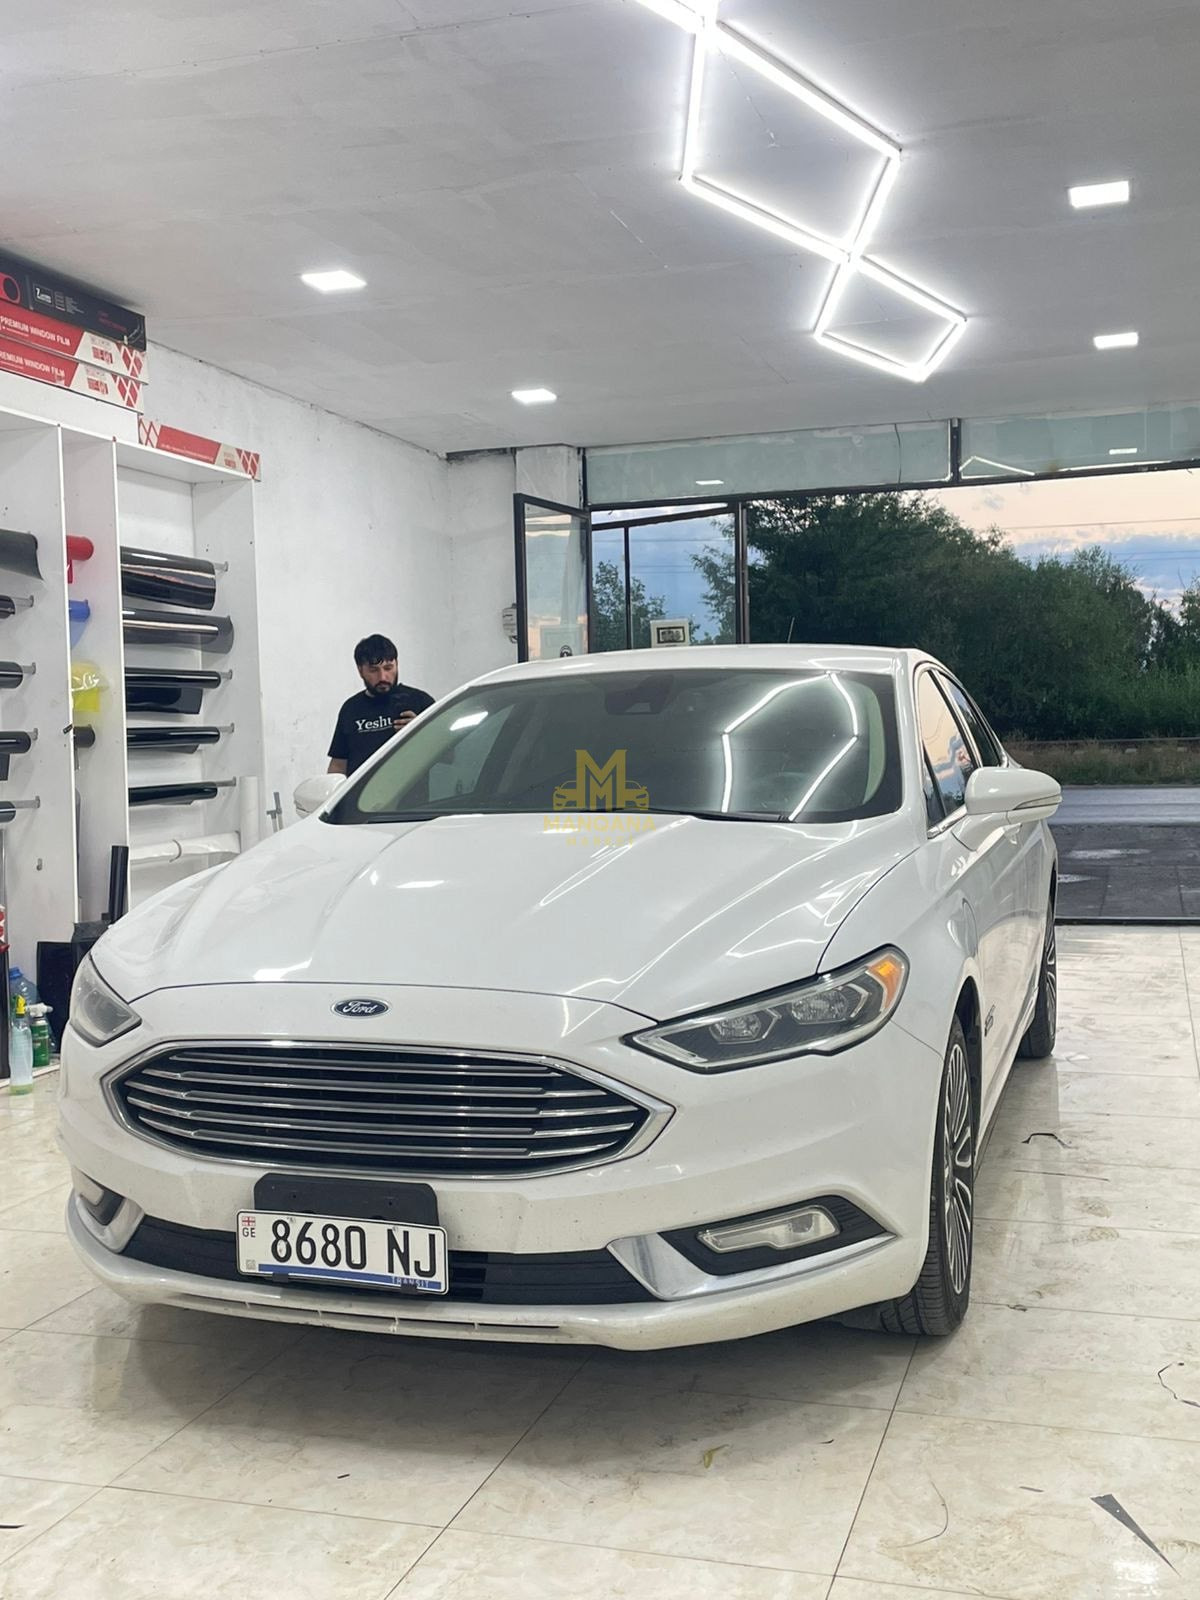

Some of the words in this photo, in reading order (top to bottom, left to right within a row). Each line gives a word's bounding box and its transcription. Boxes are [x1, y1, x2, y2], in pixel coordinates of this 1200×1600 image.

[0, 316, 29, 332] PREMIUM
[30, 326, 56, 341] WINDOW
[57, 335, 71, 346] FILM
[0, 351, 24, 365] REMIUM
[25, 358, 51, 373] WINDOW
[342, 1001, 378, 1013] Ford
[242, 1227, 256, 1238] GE
[271, 1219, 367, 1271] 8680
[387, 1229, 437, 1278] NJ
